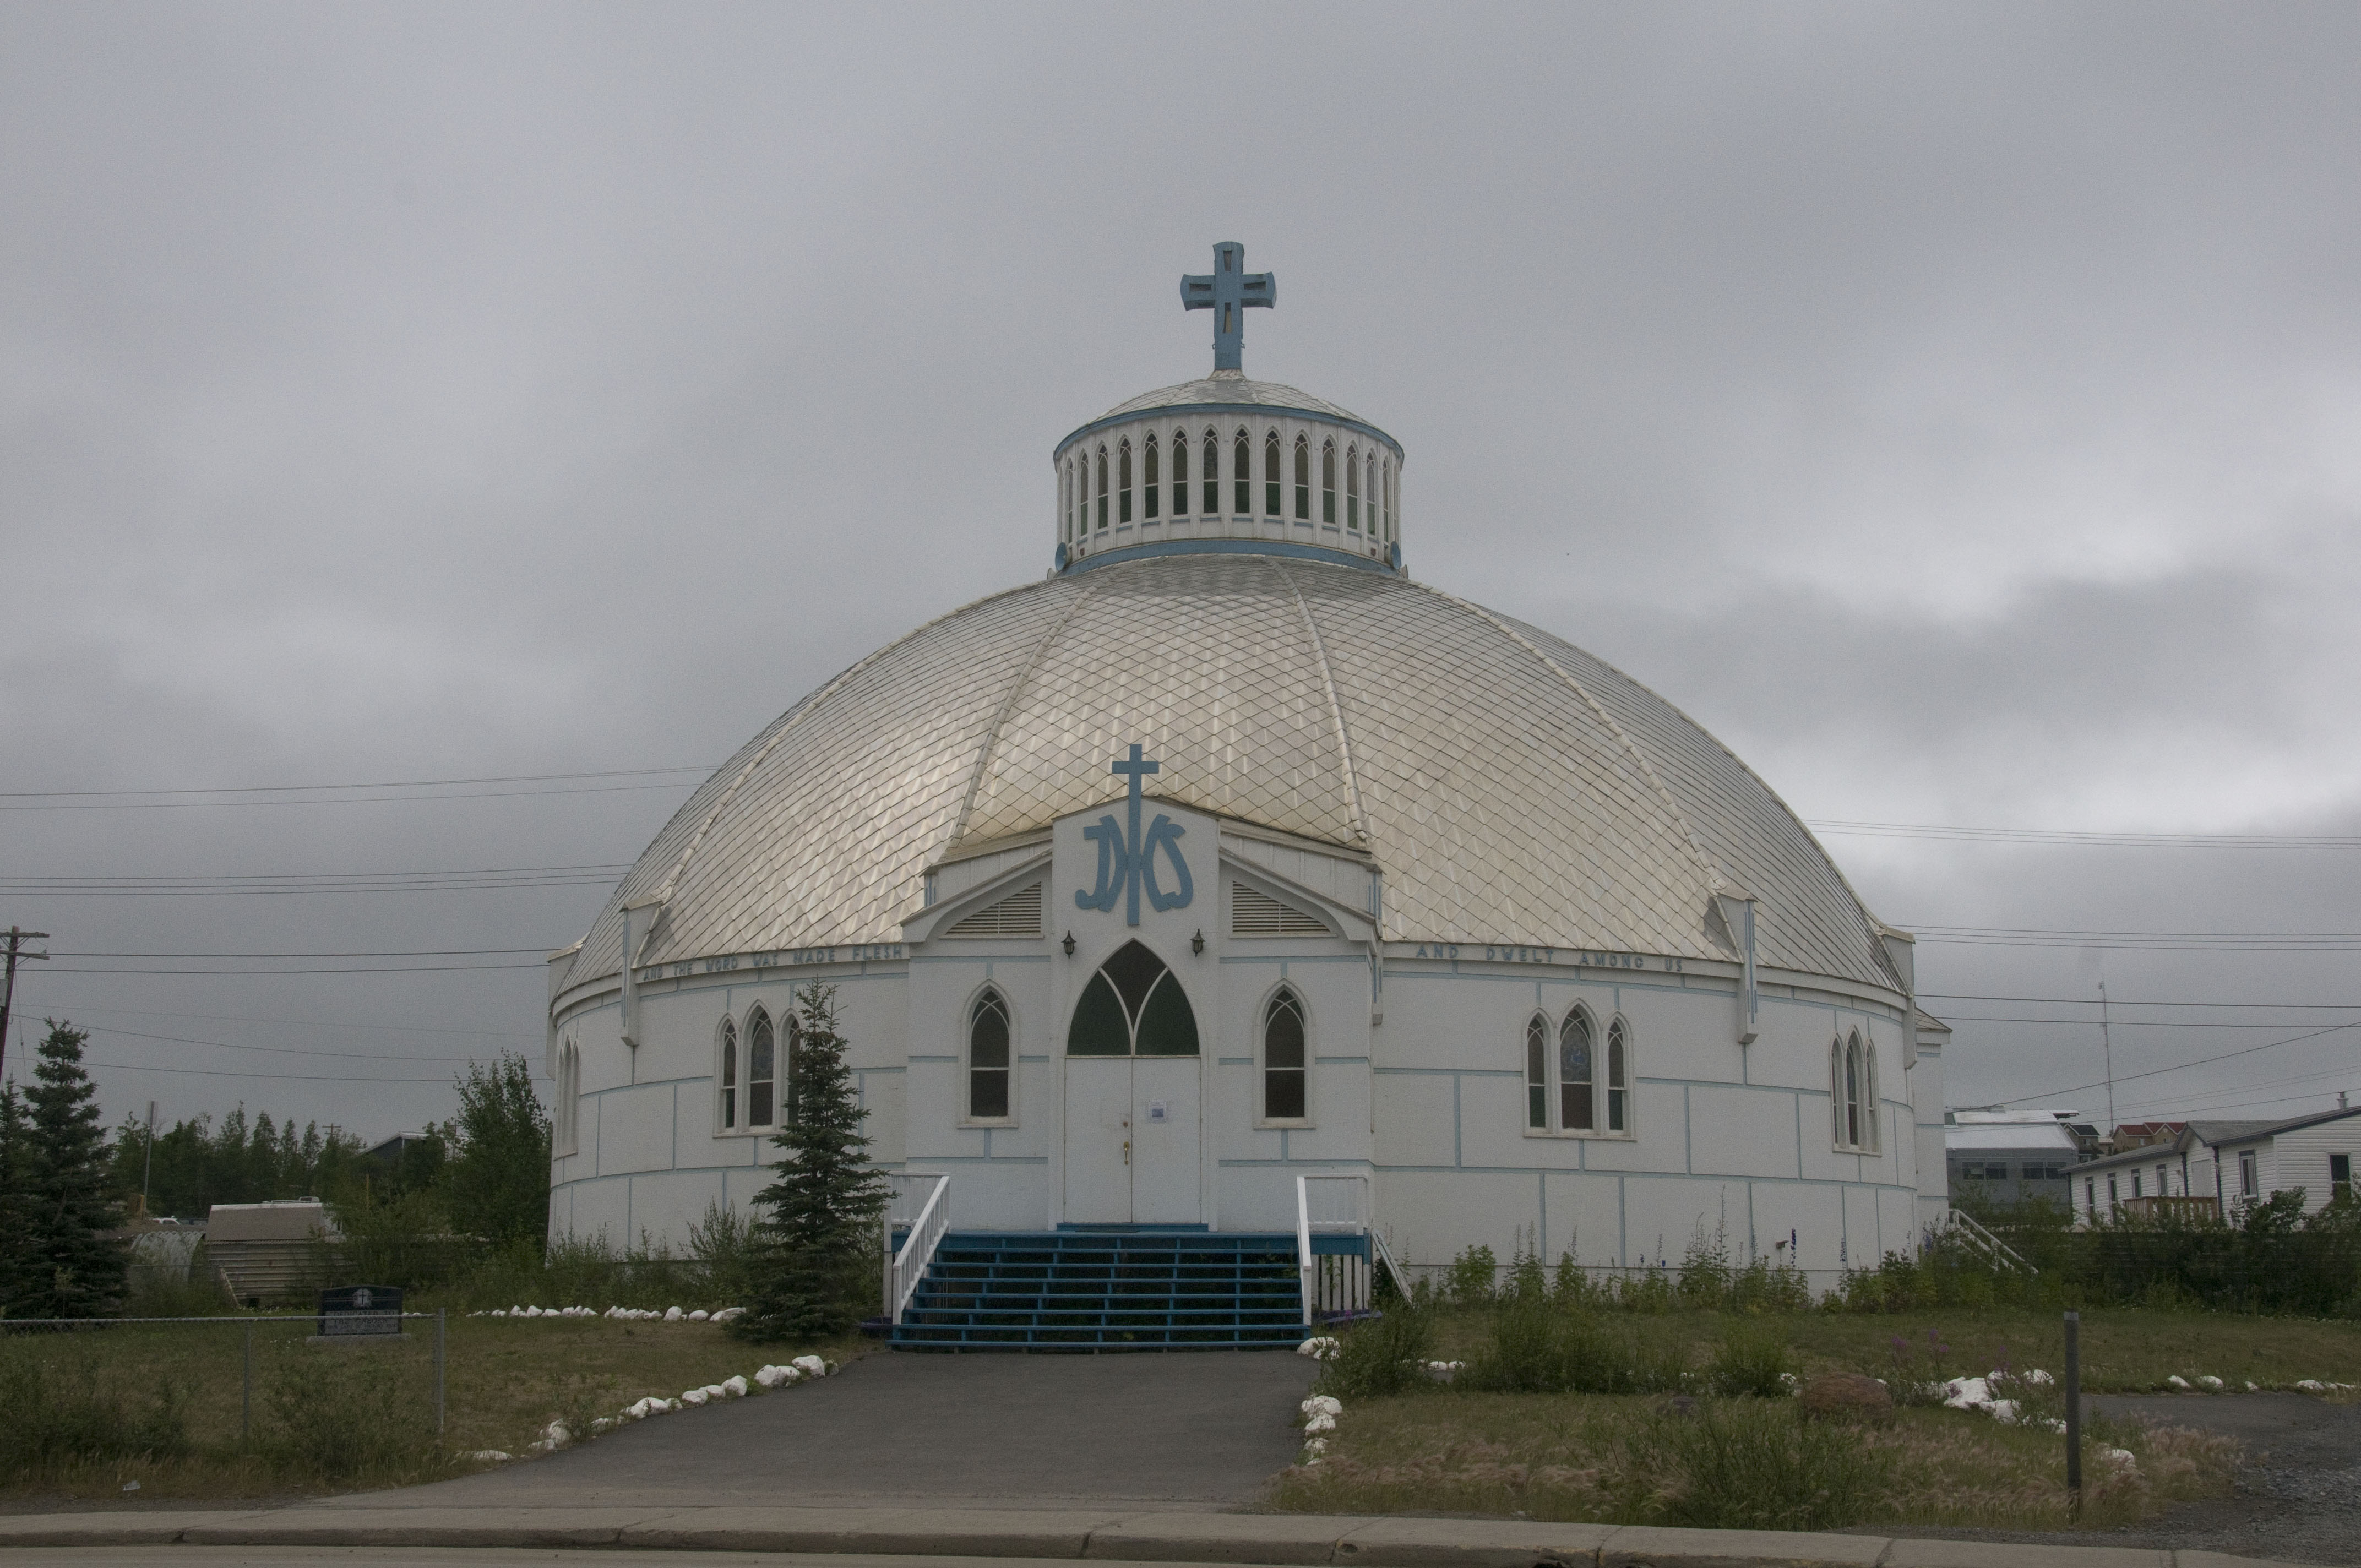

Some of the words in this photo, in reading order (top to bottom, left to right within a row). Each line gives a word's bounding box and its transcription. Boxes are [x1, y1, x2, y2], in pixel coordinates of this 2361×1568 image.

[643, 966, 663, 981] AND
[672, 961, 693, 976] THE
[705, 956, 738, 972] WORD
[753, 952, 779, 967] WAS
[793, 948, 835, 963] MADE
[853, 944, 903, 961] FLESH
[1416, 944, 1459, 959] AND
[1486, 947, 1554, 963] DWELT
[1579, 951, 1644, 968] AMONG
[1664, 957, 1683, 972] US
